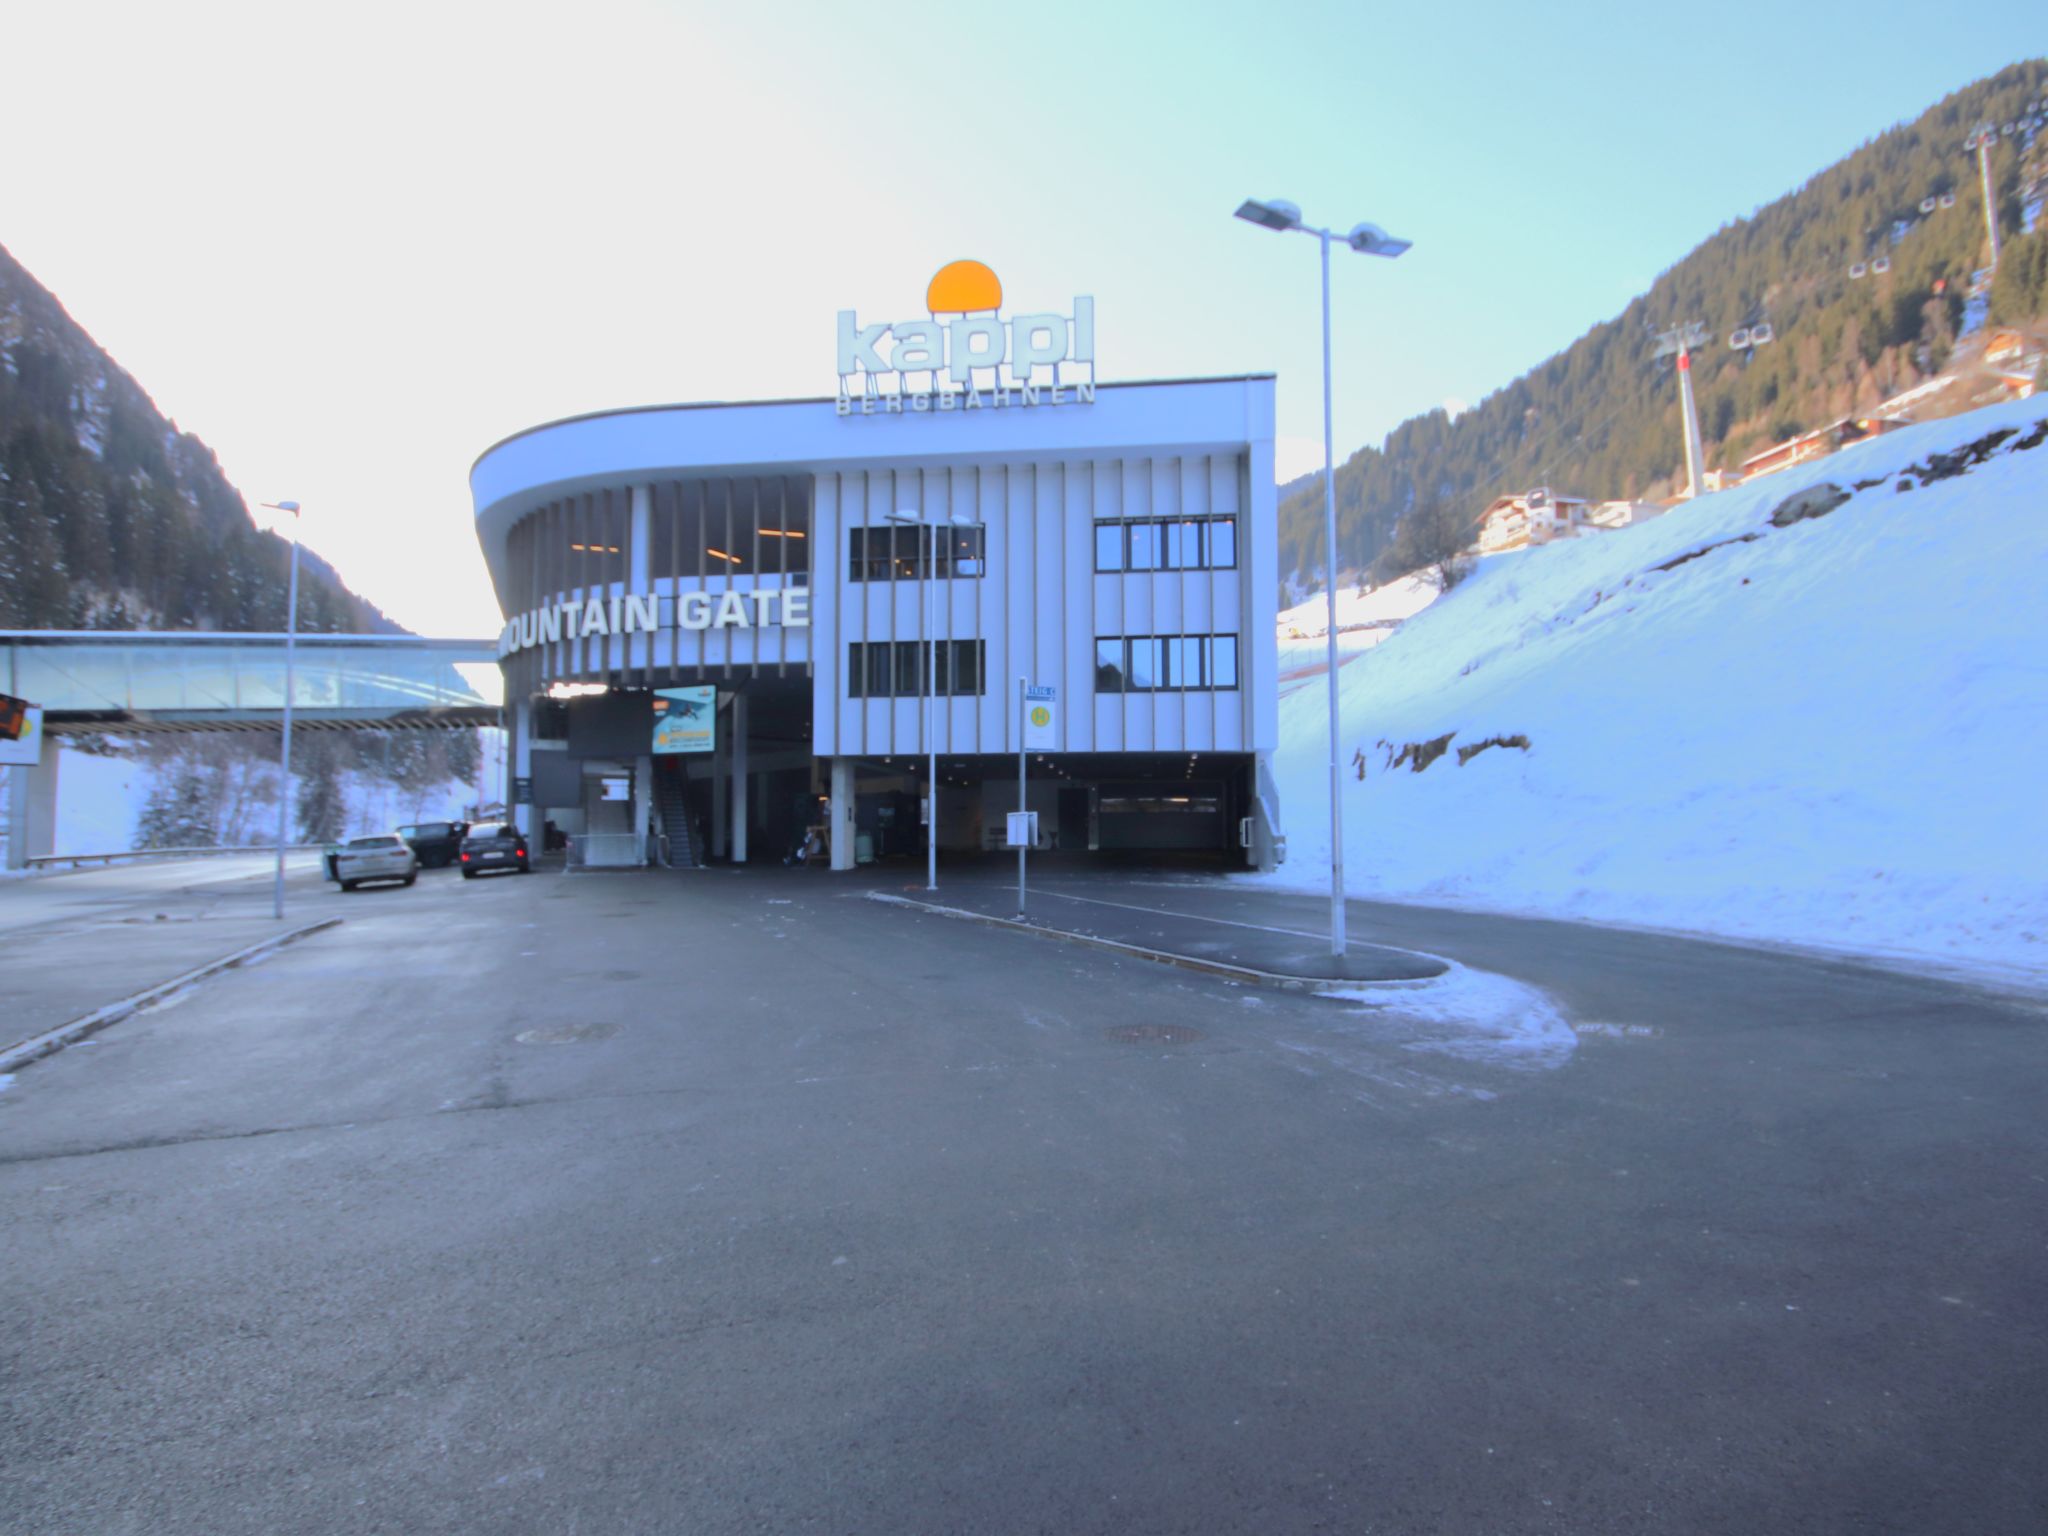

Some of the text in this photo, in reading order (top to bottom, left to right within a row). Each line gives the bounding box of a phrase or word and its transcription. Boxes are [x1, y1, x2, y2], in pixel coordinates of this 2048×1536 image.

[837, 296, 1094, 383] kappl
[836, 383, 1096, 416] BERGBAHNEN
[498, 586, 810, 659] OUNTAIN GATE
